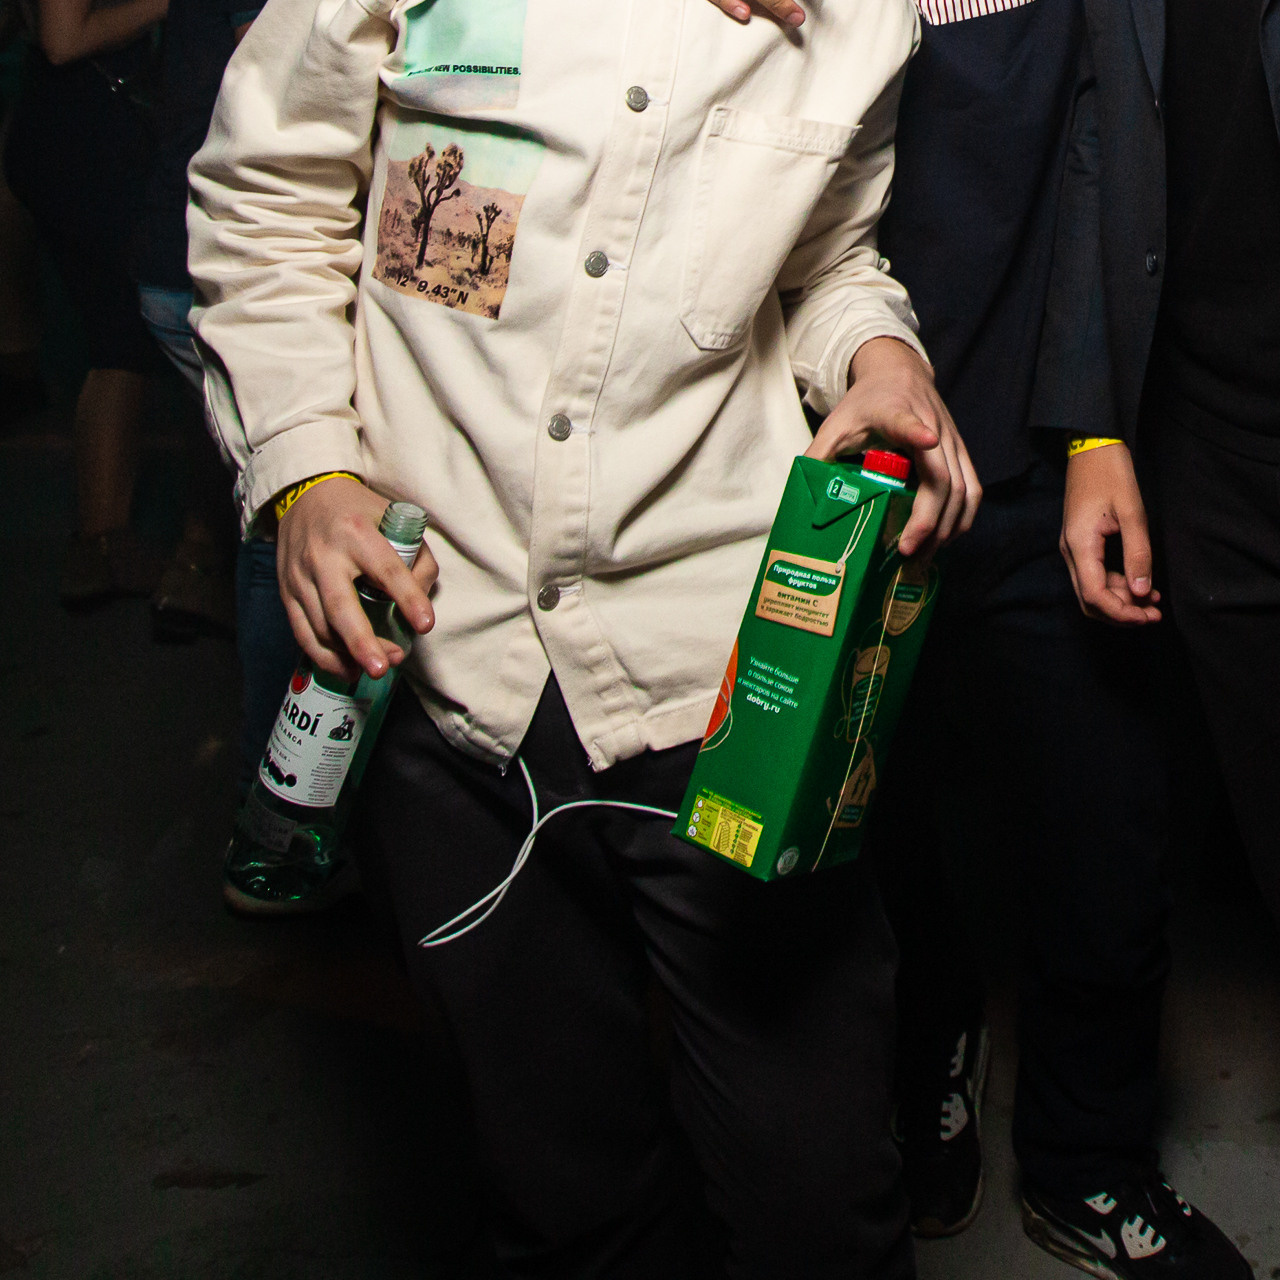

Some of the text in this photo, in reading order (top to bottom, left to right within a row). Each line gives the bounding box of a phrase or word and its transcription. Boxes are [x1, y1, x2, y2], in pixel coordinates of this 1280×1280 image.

[452, 65, 521, 75] POSSIBILITIES.
[832, 484, 839, 494] 2
[773, 564, 837, 586] Природная польза
[787, 576, 818, 590] фруктов
[777, 591, 811, 606] витамин
[750, 656, 799, 685] Узнайте больше
[752, 671, 774, 686] пользе
[774, 681, 794, 694] соков
[741, 679, 771, 697] нектаров
[770, 692, 780, 701] на
[779, 696, 799, 709] сайте
[746, 692, 781, 713] dobry.ru
[282, 696, 323, 737] ARDÍ
